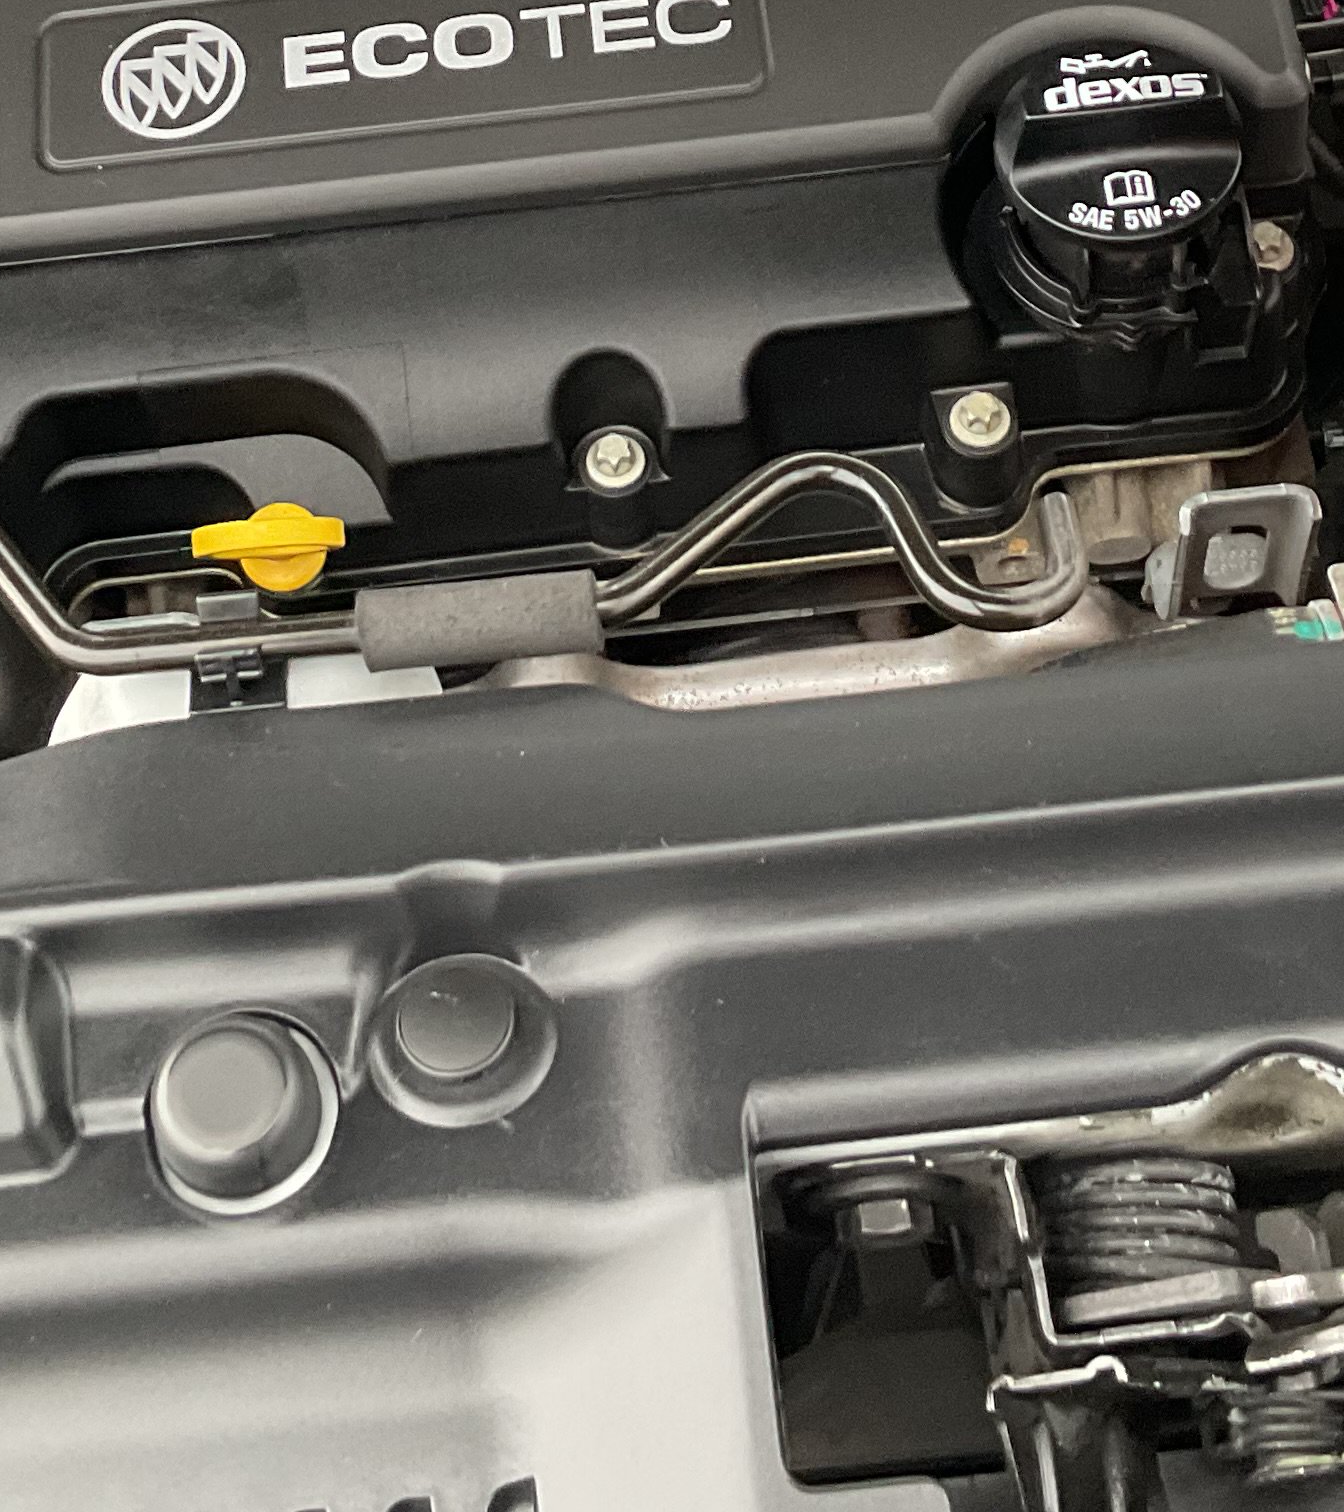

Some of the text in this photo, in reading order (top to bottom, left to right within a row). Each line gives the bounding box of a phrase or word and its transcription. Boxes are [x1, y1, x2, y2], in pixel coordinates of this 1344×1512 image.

[1043, 73, 1206, 113] dexos
[1068, 189, 1202, 231] SAE 5W-30
